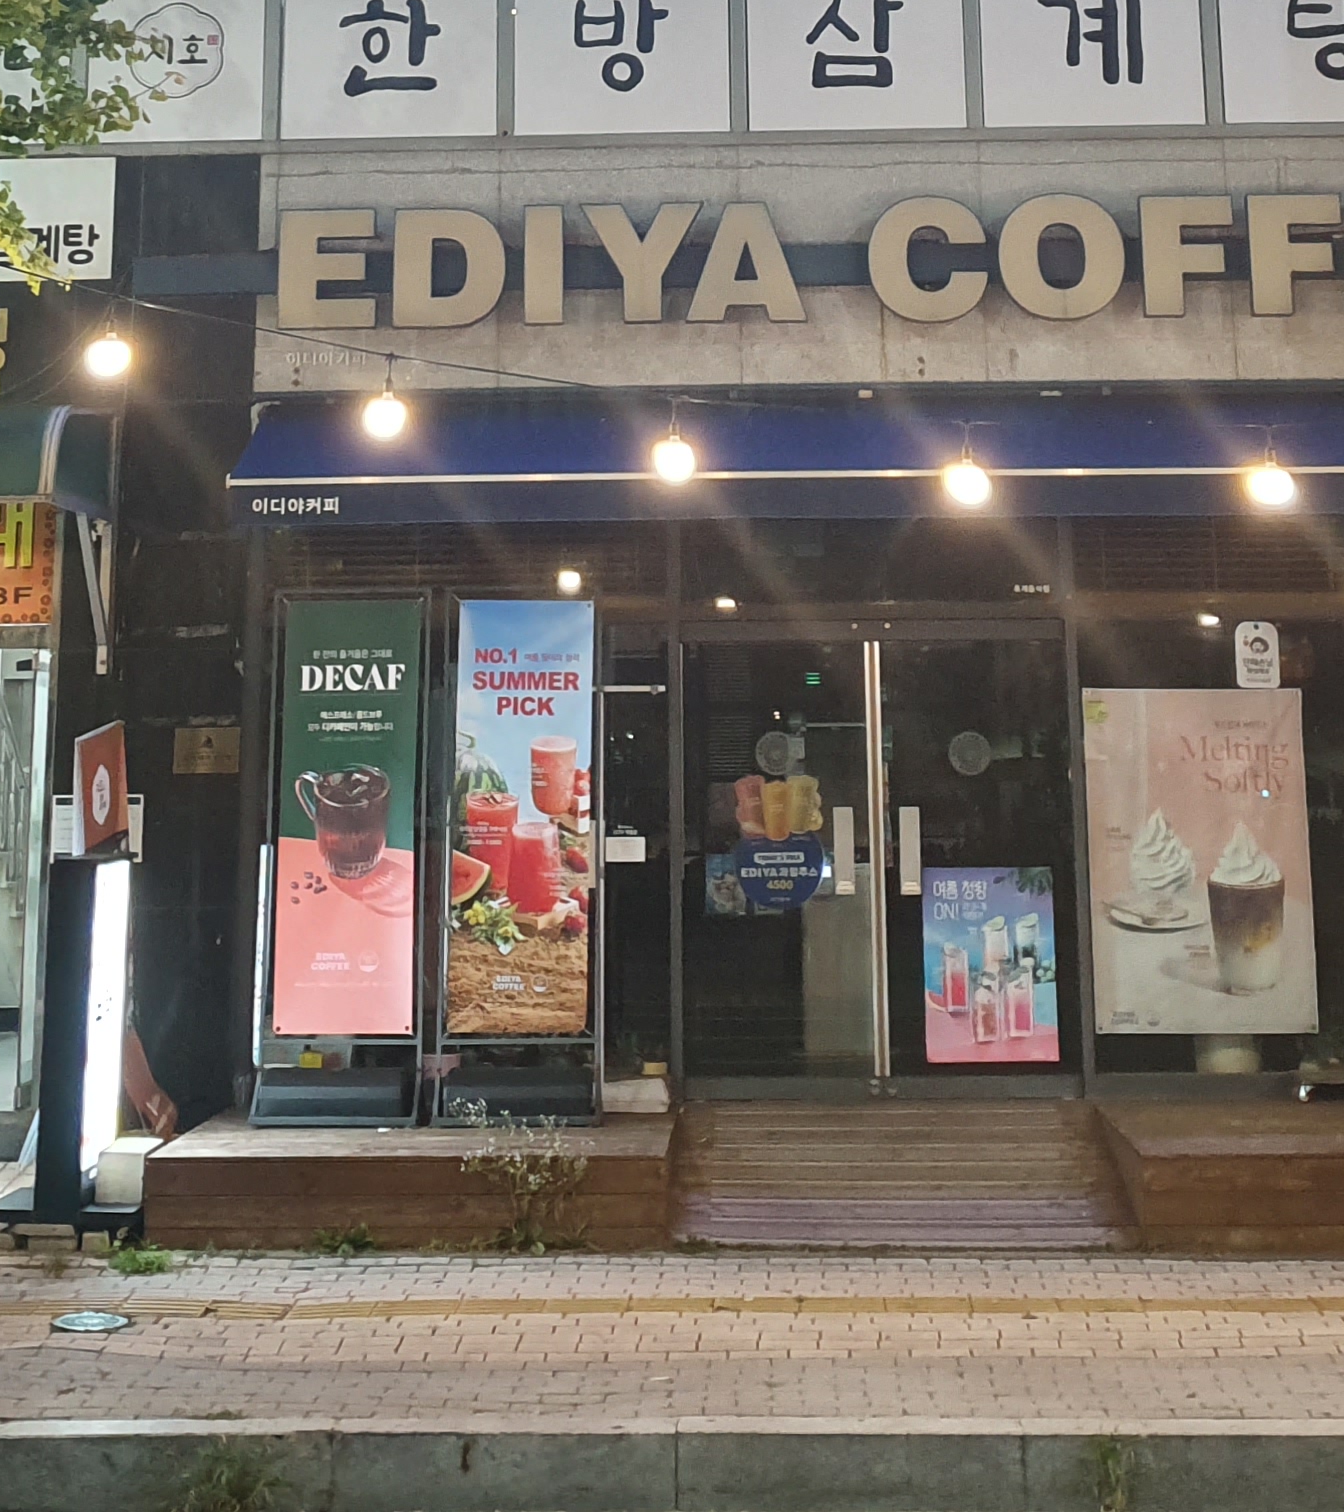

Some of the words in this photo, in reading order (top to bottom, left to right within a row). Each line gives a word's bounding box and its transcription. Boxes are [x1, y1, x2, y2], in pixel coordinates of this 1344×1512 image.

[276, 199, 809, 331] EDIYA
[251, 496, 341, 515] 이디야커피
[474, 647, 518, 664] NO.1
[299, 662, 407, 693] DECAF
[472, 670, 580, 691] SUMMER
[496, 696, 556, 717] PICK
[1179, 734, 1289, 770] Melting
[1203, 765, 1284, 800] Softly
